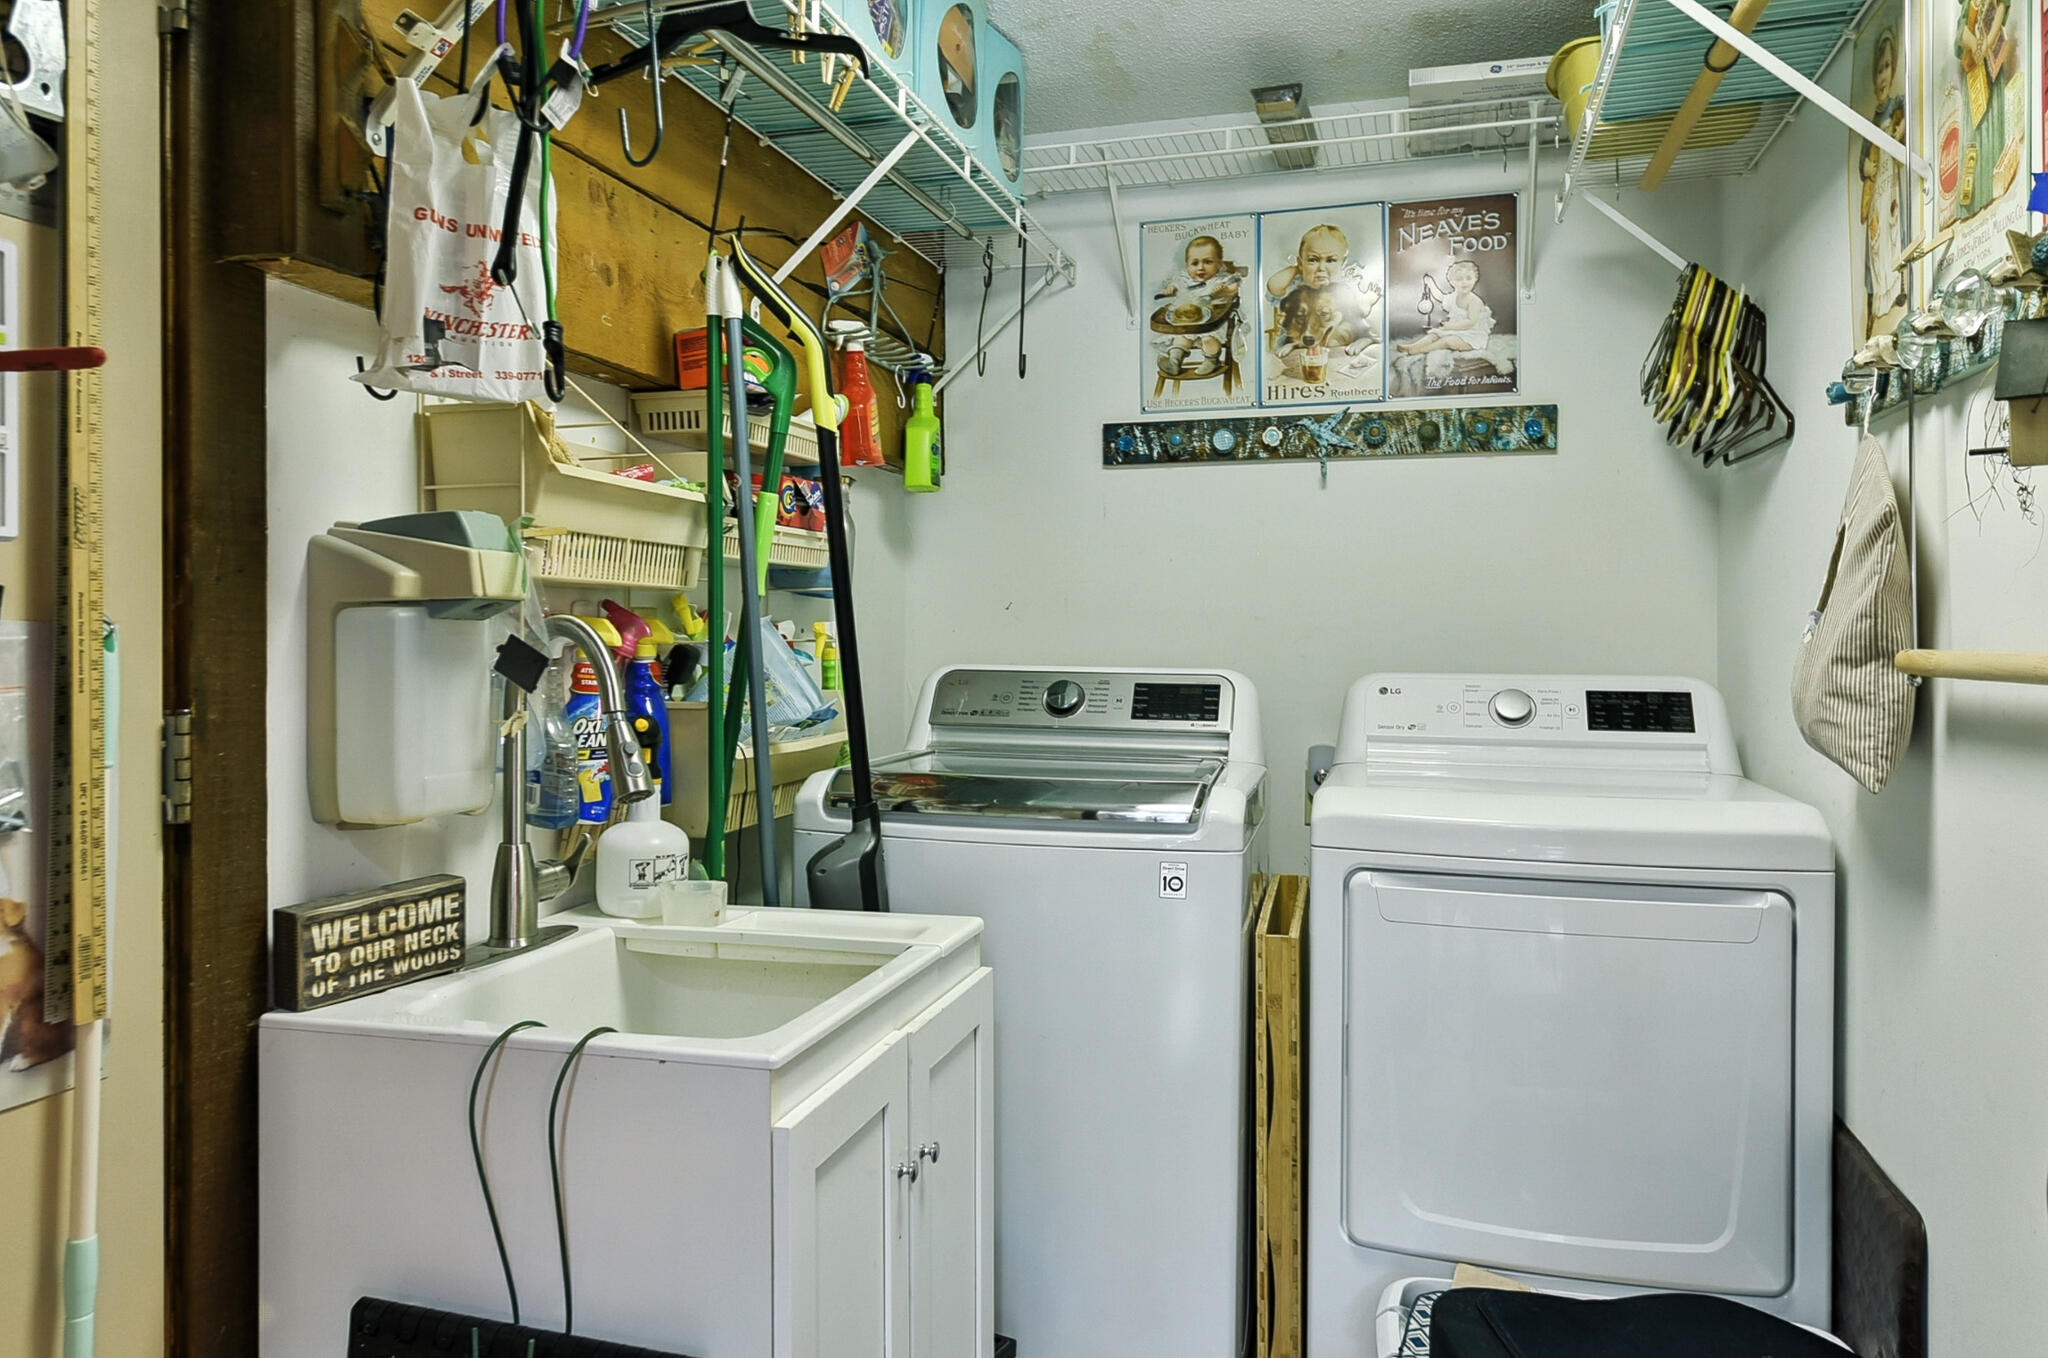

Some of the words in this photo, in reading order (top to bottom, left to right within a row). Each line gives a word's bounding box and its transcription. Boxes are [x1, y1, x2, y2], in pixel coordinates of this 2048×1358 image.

[413, 206, 458, 233] GUNS
[1175, 221, 1231, 240] BUCKWHEAT
[1220, 230, 1248, 240] BABY
[1397, 209, 1500, 255] NEAVE'S
[449, 369, 483, 380] Street
[496, 370, 544, 381] 339-0771
[1443, 375, 1467, 386] Food
[1331, 388, 1381, 398] Rootbeer
[1389, 687, 1402, 695] LG
[578, 733, 608, 748] EAN
[1162, 875, 1184, 892] 10
[311, 892, 460, 953] WELCOME
[310, 952, 341, 977] TO
[350, 938, 396, 967] OUR
[404, 922, 460, 953] NECK
[311, 977, 339, 998] OF
[349, 963, 385, 988] THE
[393, 945, 461, 976] WOODS
